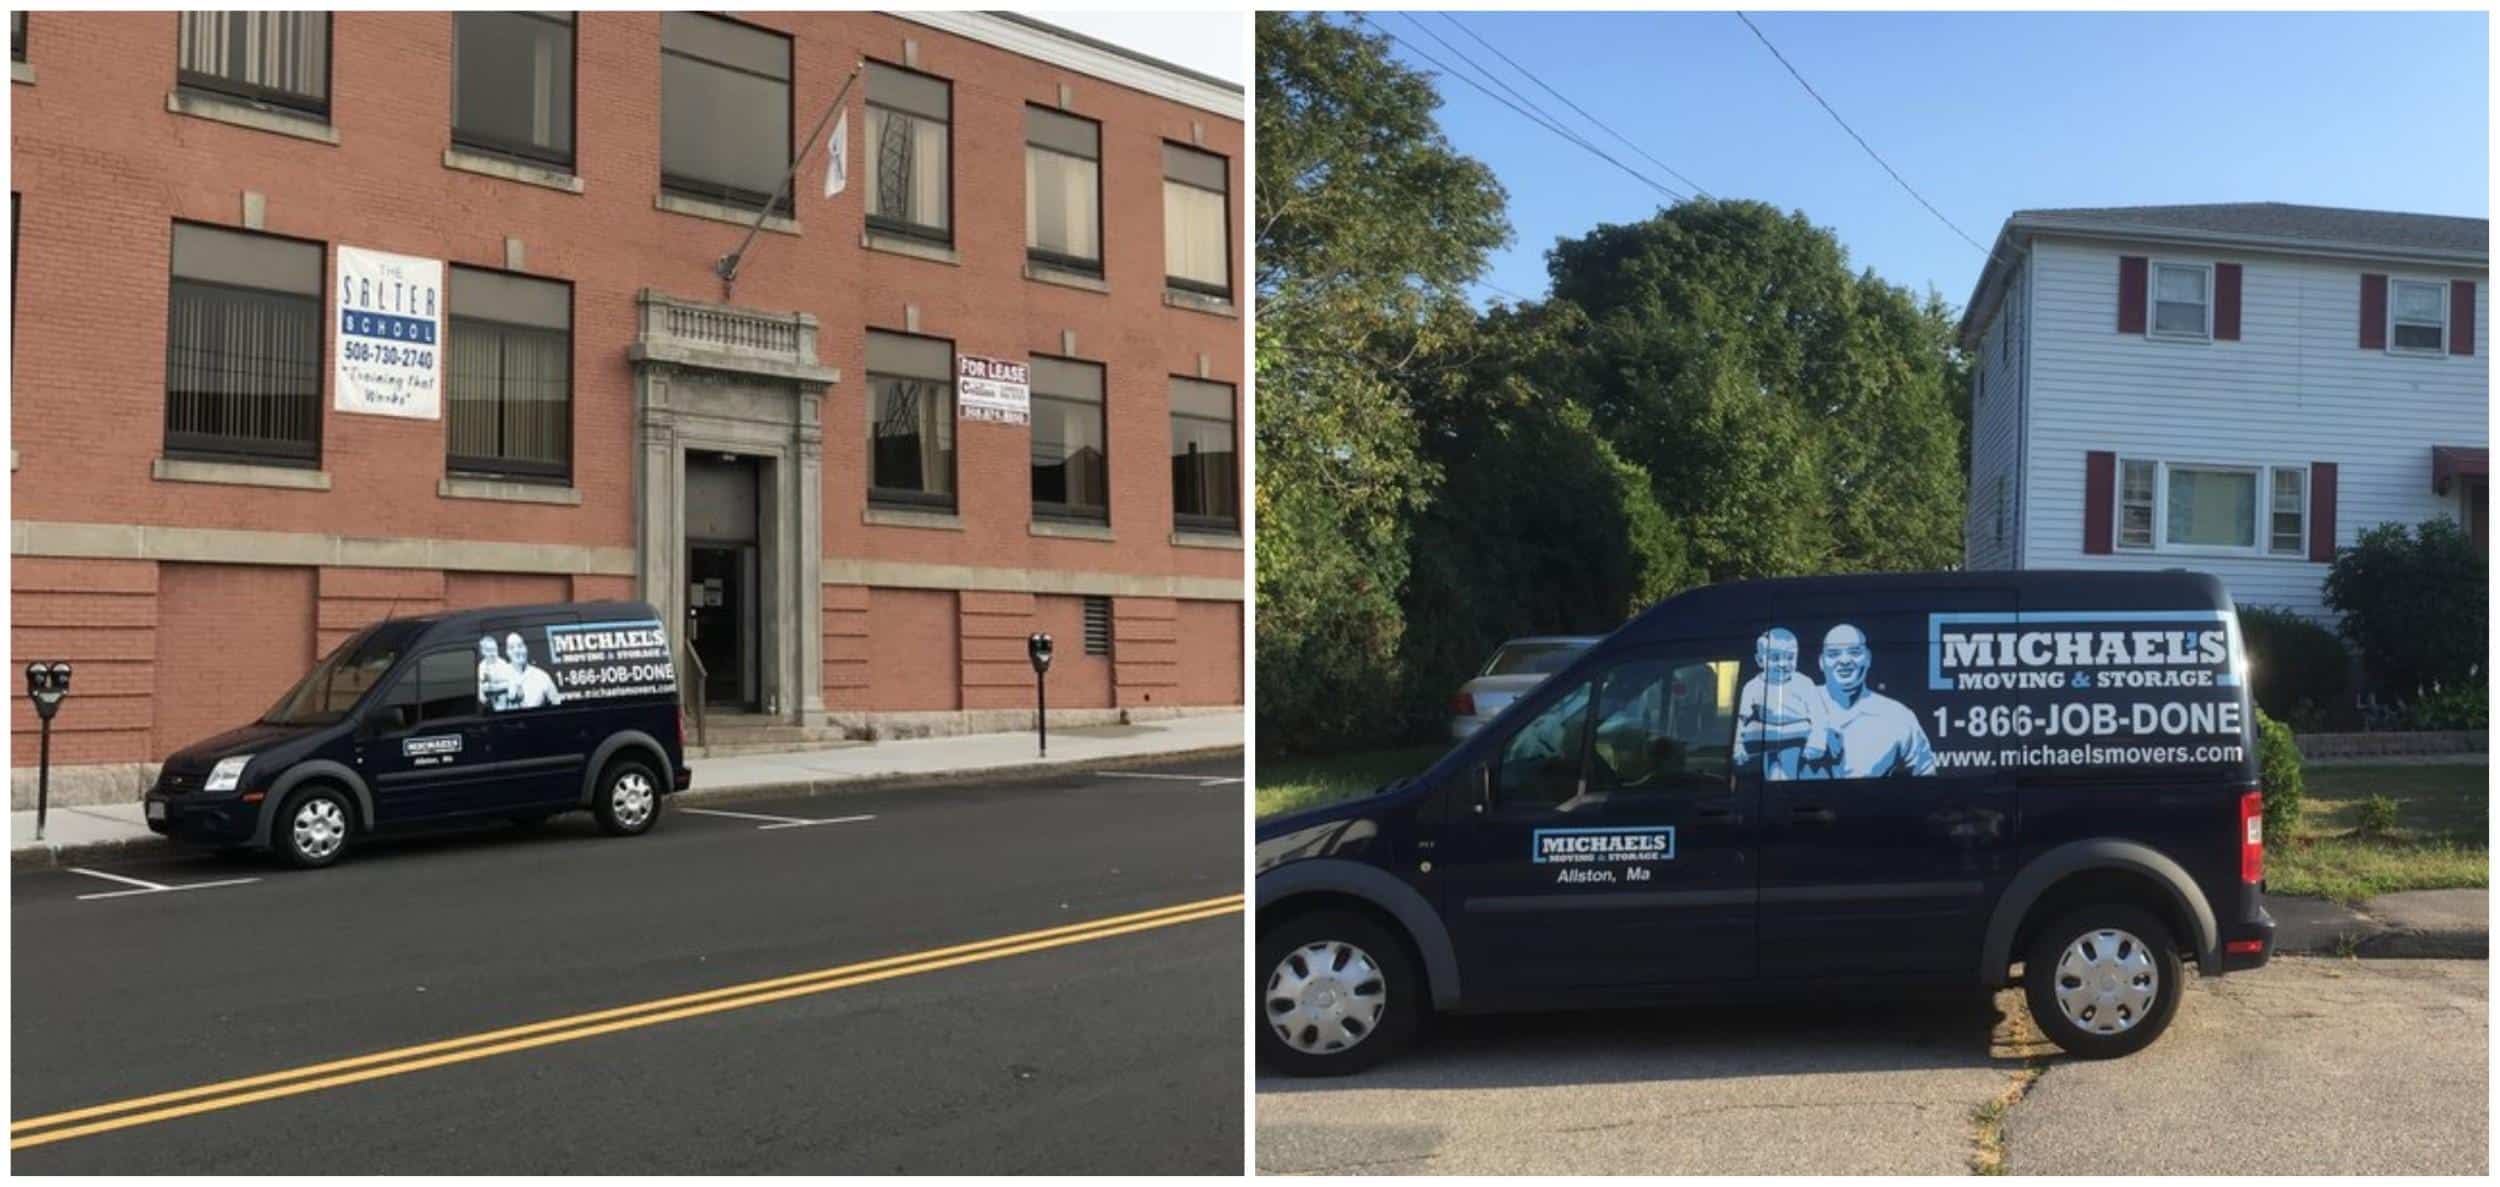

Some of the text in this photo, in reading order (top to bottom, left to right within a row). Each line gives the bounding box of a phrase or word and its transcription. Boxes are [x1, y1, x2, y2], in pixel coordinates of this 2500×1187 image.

[380, 264, 404, 278] THE
[344, 275, 436, 317] SALTER
[345, 315, 433, 342] SCHOOL
[344, 340, 434, 370] 508-730-2740
[961, 358, 1026, 383] FOR LEASE
[1942, 629, 2226, 668] MICHAEL'S
[556, 663, 675, 687] 1-866-JOB-DONE
[1958, 670, 2213, 690] MOVING & STORAGE
[1932, 702, 2241, 738] 1-866-JOB-DONE
[1934, 743, 2244, 768] www.michaelsmovers.com
[1550, 853, 1595, 863] MOVING
[1608, 851, 1659, 861] STORAGE
[1556, 866, 1651, 883] Allston, Ma
